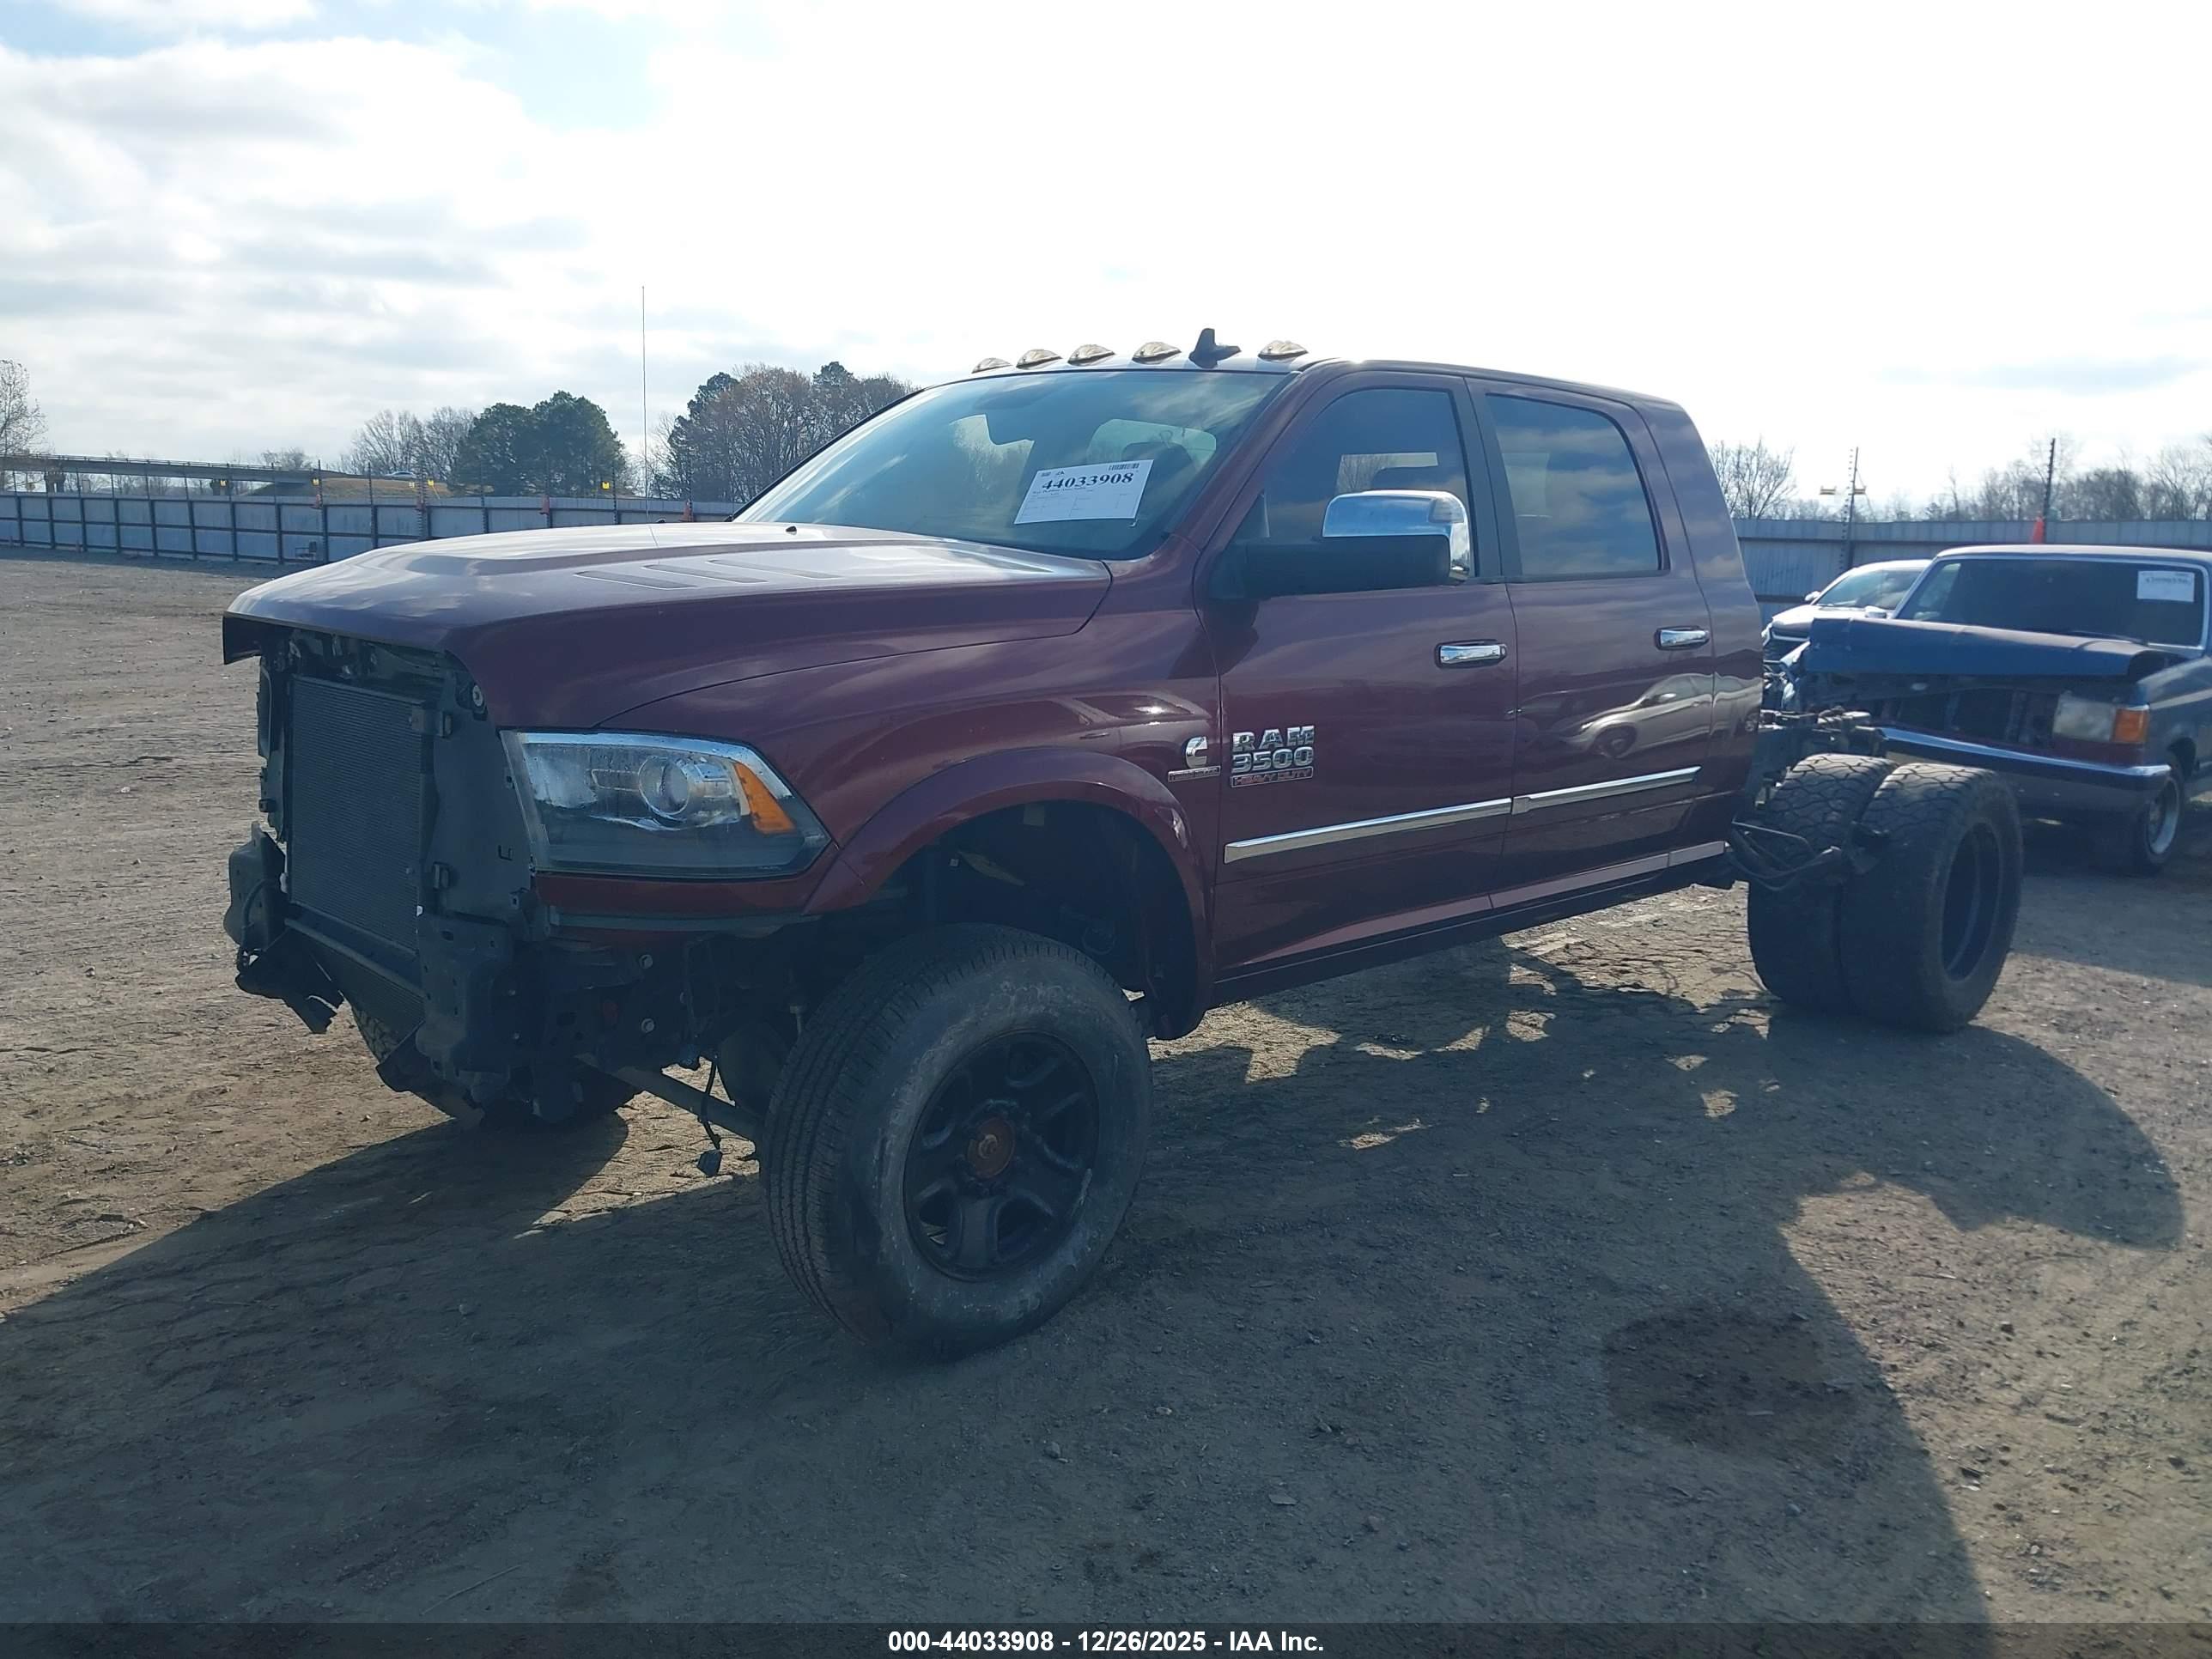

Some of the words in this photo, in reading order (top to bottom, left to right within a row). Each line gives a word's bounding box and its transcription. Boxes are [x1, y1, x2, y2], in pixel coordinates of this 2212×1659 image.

[1042, 472, 1134, 490] 44033908
[1232, 725, 1315, 752] RAM
[1231, 746, 1314, 774] 3500
